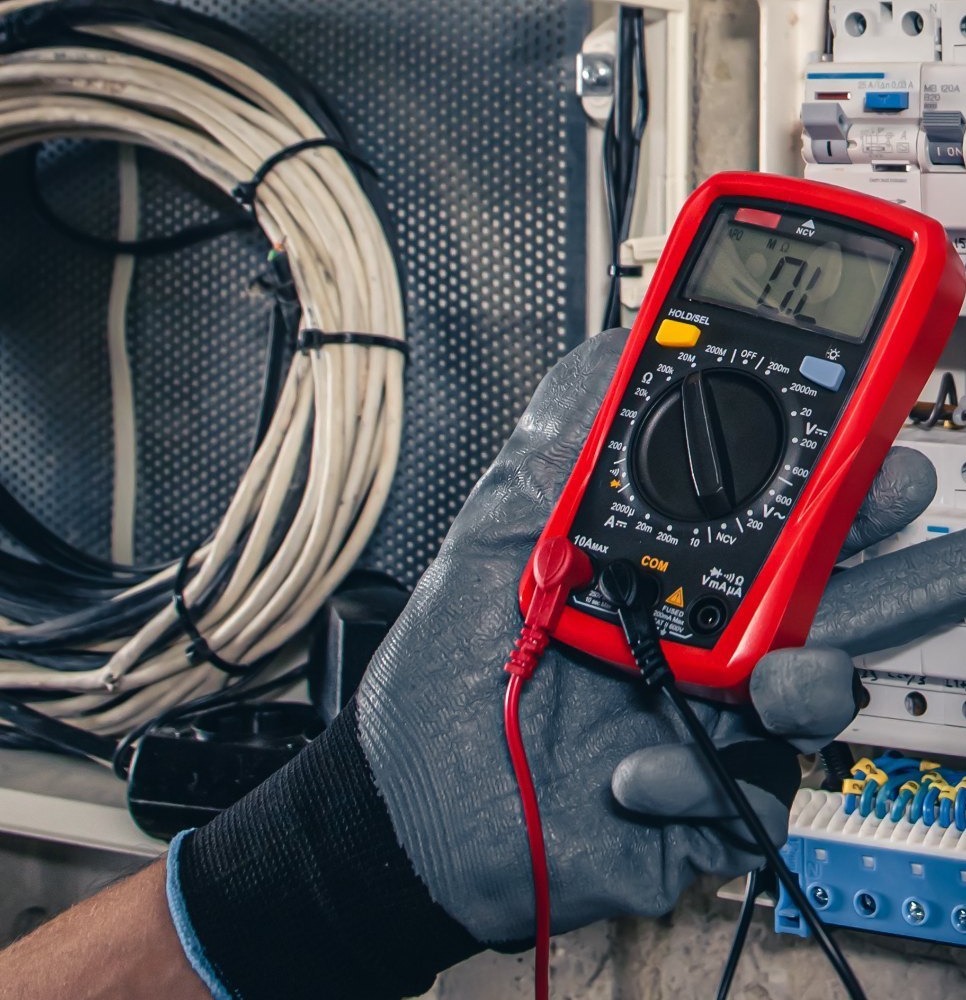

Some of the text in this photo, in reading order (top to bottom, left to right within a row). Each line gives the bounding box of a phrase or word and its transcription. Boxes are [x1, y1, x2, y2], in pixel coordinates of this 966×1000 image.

[929, 3, 937, 13] N
[947, 147, 964, 156] ON
[795, 227, 815, 237] NCV
[668, 307, 710, 325] HOLD/SEL
[705, 344, 727, 356] 200M
[740, 349, 758, 360] OFF
[677, 352, 697, 362] 20M
[767, 361, 790, 375] 200m
[789, 382, 817, 397] 2000m
[620, 408, 638, 418] 2000
[800, 407, 812, 417] 20
[608, 440, 622, 450] 200
[800, 438, 817, 449] 200
[792, 466, 809, 478] 600
[775, 495, 792, 506] 600
[635, 521, 653, 533] 20m
[746, 519, 763, 530] 200
[656, 532, 679, 545] 200m
[690, 537, 700, 547] 10
[715, 532, 737, 545] NCV
[641, 555, 669, 573] COM
[661, 605, 685, 617] FUSED
